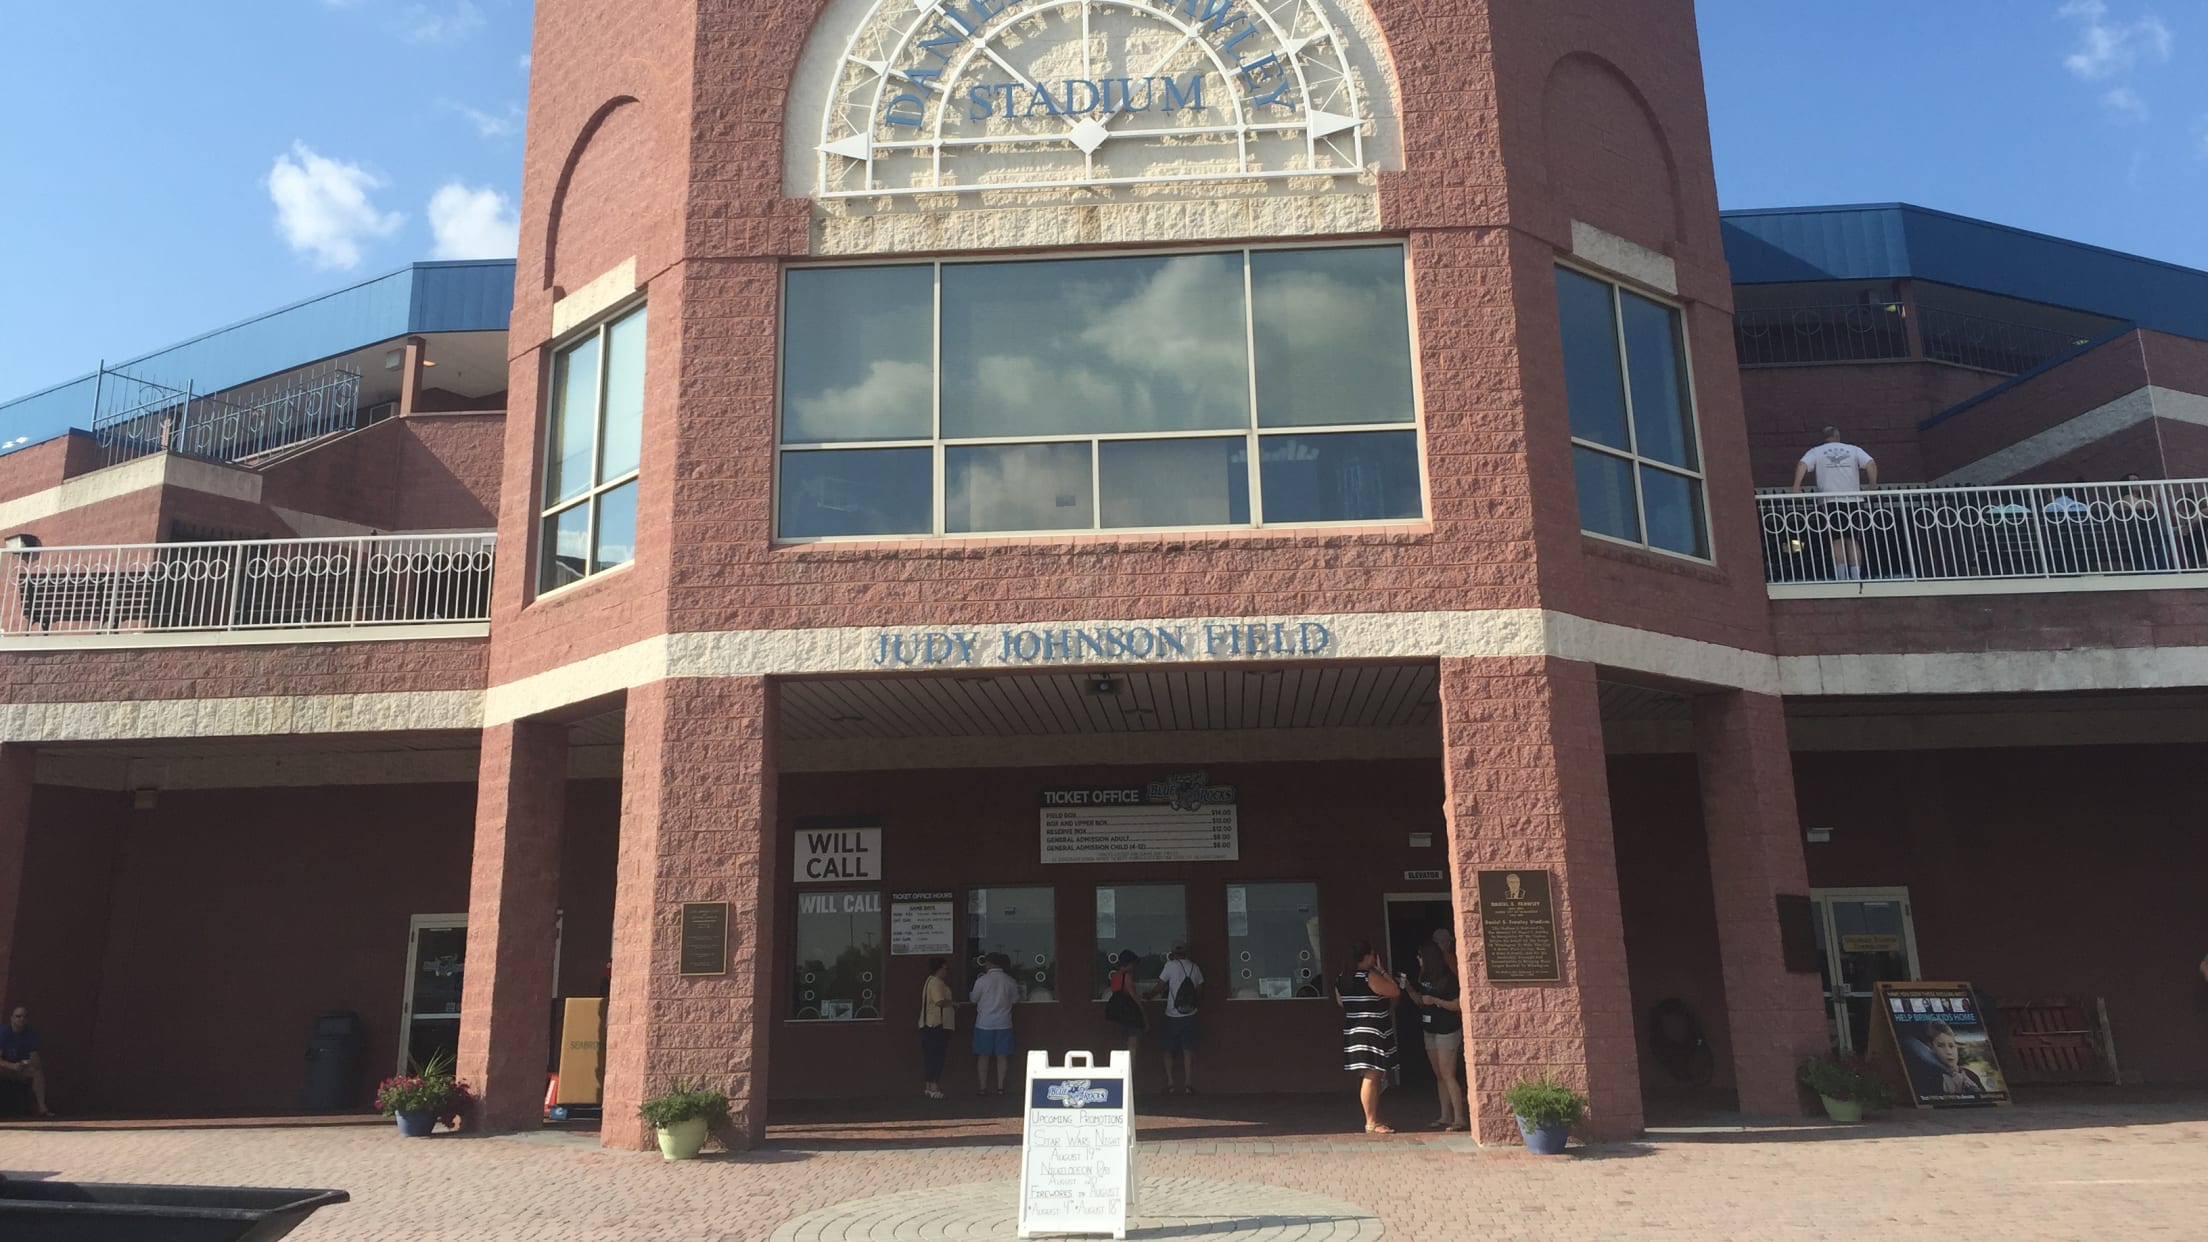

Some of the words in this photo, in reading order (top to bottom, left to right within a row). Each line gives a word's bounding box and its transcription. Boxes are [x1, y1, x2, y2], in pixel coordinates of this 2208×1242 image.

[969, 74, 1207, 121] STADIUM
[873, 630, 980, 666] JUDY
[997, 625, 1185, 662] JOHNSON
[1203, 621, 1330, 656] FIELD
[1044, 790, 1089, 804] TICKET
[1092, 789, 1139, 803] OFFICE
[807, 832, 869, 854] WILL
[806, 857, 869, 879] CALL
[1408, 871, 1440, 879] ELEVATOR
[801, 895, 837, 914] WILL
[843, 894, 882, 913] CALL
[1895, 1013, 1913, 1022] HELP
[1914, 1013, 1936, 1022] BRING
[1936, 1013, 1954, 1022] KIDS
[1955, 1013, 1977, 1022] HOME
[1032, 1111, 1073, 1124] UPCOMING
[1080, 1110, 1123, 1124] PROMOTIONS
[1034, 1129, 1061, 1146] STAR
[1065, 1129, 1089, 1145] WARS
[1095, 1128, 1120, 1145] NIGHT
[1051, 1148, 1080, 1161] AUGUST
[1048, 1175, 1077, 1186] AUGUST
[1031, 1185, 1073, 1199] FIREWORKS
[1089, 1184, 1120, 1198] AUGUST
[1032, 1202, 1060, 1216] AUGUST
[1078, 1200, 1105, 1216] AUGUST
